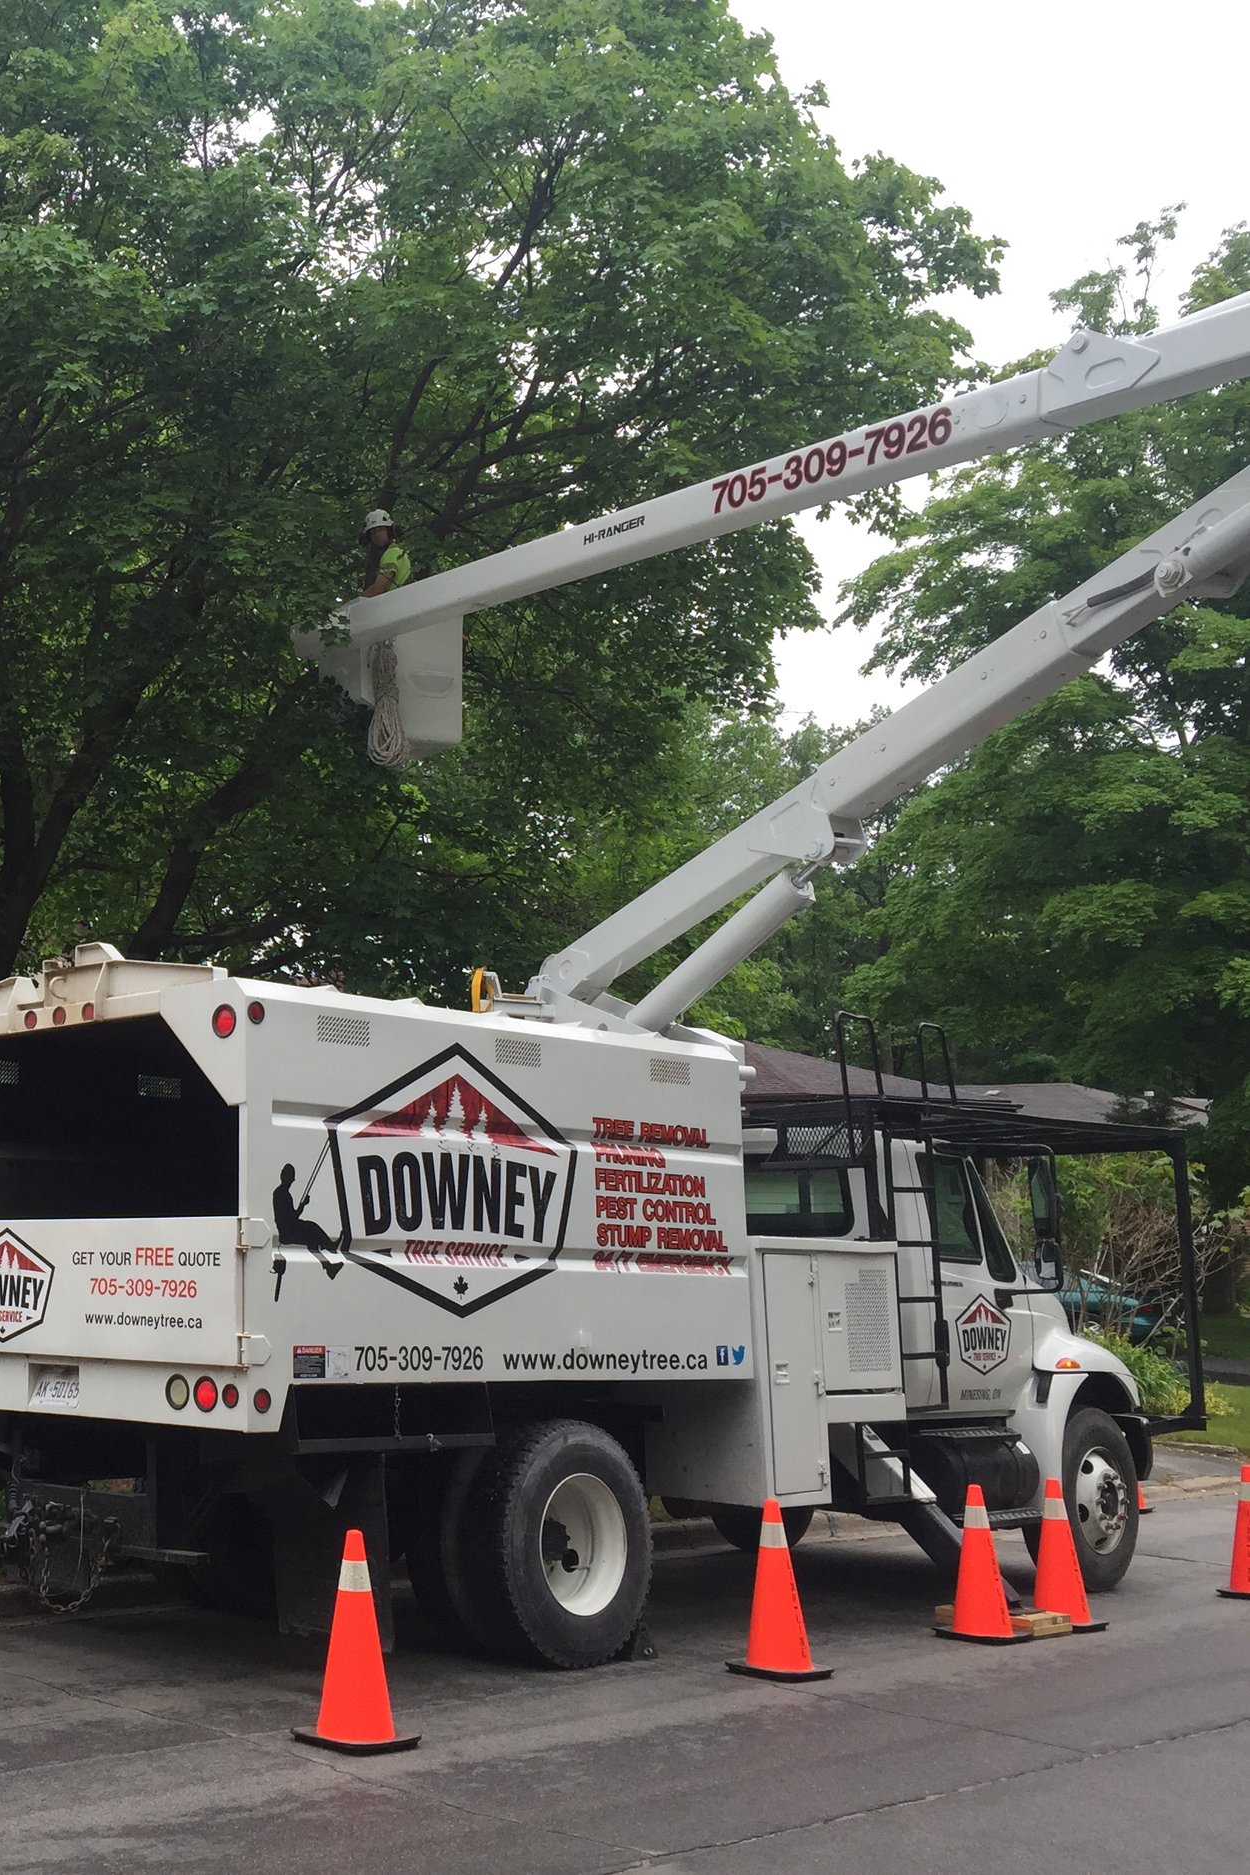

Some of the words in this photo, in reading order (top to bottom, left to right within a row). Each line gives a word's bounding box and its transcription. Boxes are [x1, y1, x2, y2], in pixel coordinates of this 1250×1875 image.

[712, 407, 952, 514] 705-309-7926
[583, 515, 646, 545] HI-RANGER
[593, 1117, 635, 1140] TREE
[638, 1122, 710, 1149] REMOVAL
[591, 1141, 666, 1168] PRUNING
[595, 1167, 706, 1198] FERTILIZATION
[356, 1151, 558, 1243] DOWNEY
[595, 1195, 637, 1220] PEST
[642, 1198, 716, 1225] CONTROL
[596, 1222, 652, 1248] STUMP
[657, 1226, 728, 1252] REMOVAL
[72, 1251, 95, 1266] GET
[100, 1251, 132, 1266] YOUR
[135, 1247, 175, 1266] FREE
[178, 1251, 221, 1267] QUOTE
[404, 1239, 444, 1265] TREE
[444, 1240, 508, 1267] SERVICE
[592, 1250, 634, 1273] 24/7
[635, 1251, 735, 1275] EMERGENCY
[90, 1277, 197, 1298] 705-309-7926
[85, 1311, 203, 1330] www.downeytree.ca
[962, 1326, 1007, 1353] DOWNEY
[354, 1345, 484, 1371] 705-309-7926
[503, 1348, 708, 1374] www.downeytree.ca
[35, 1380, 50, 1398] AK
[52, 1380, 80, 1399] 50165
